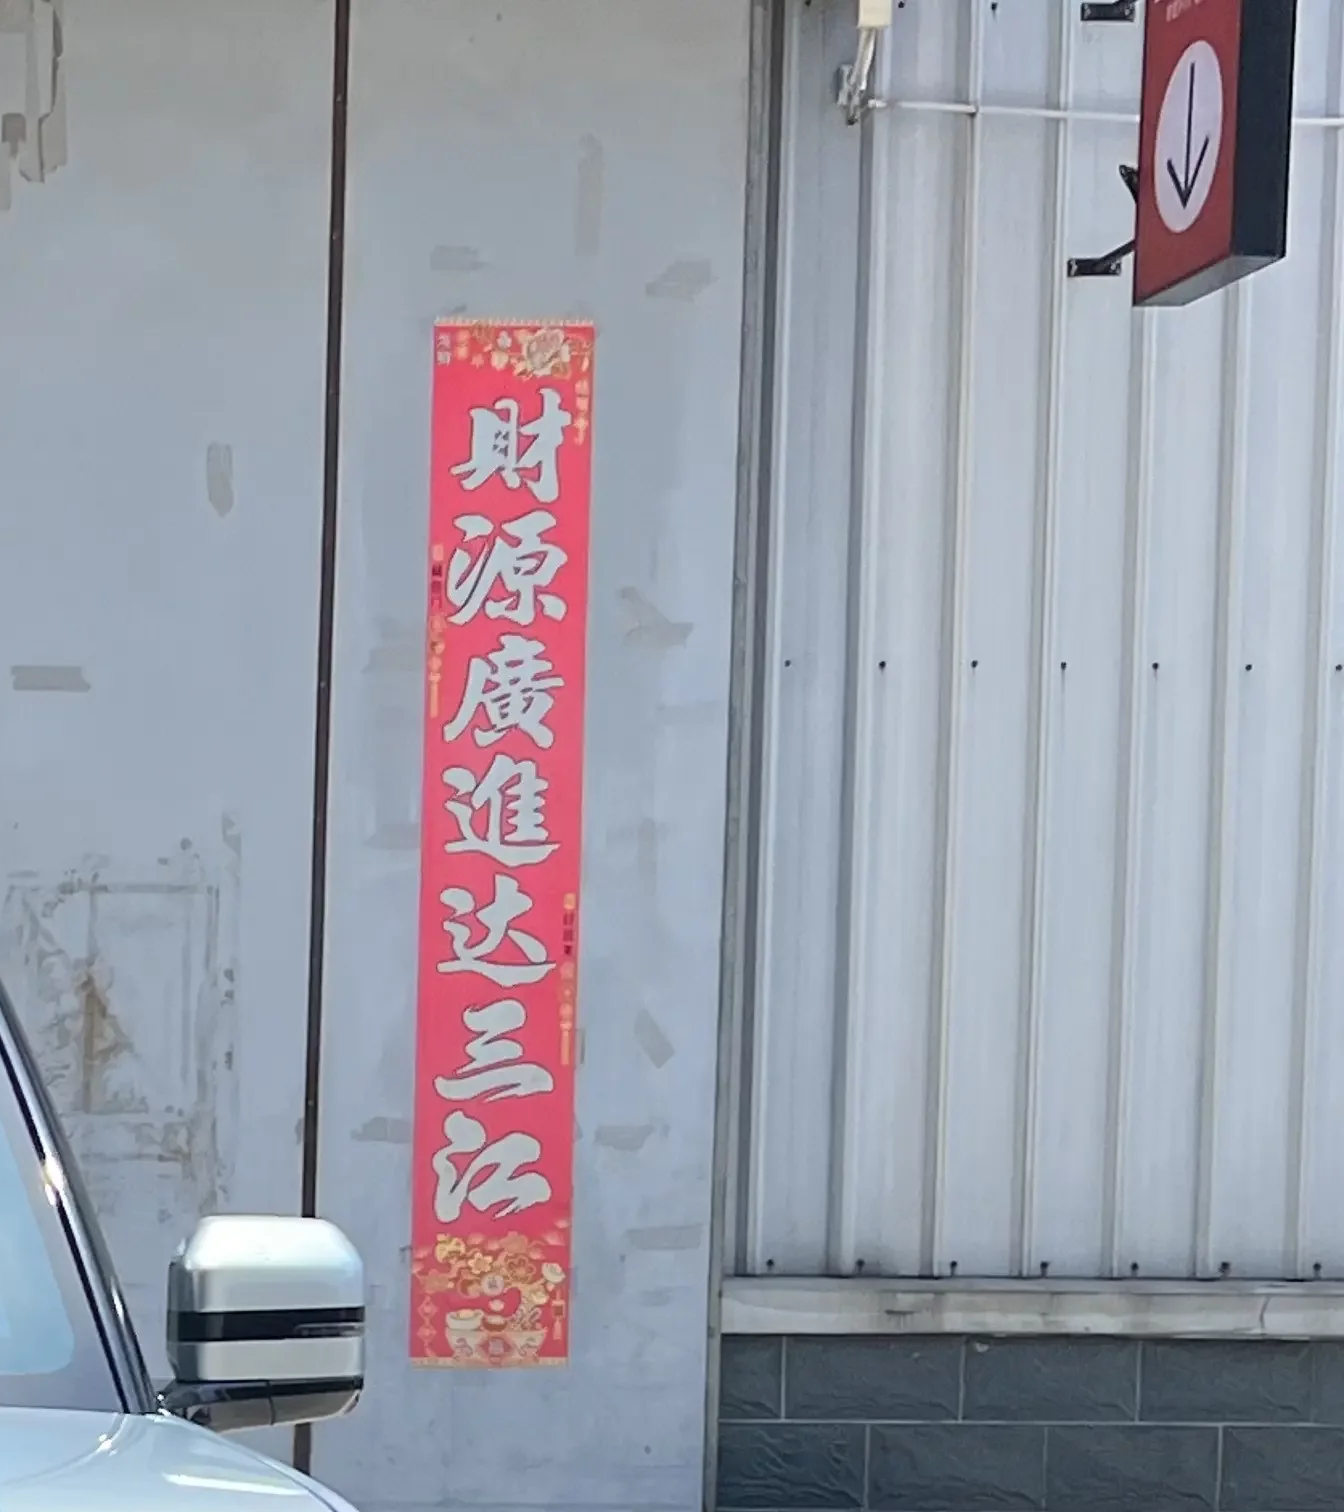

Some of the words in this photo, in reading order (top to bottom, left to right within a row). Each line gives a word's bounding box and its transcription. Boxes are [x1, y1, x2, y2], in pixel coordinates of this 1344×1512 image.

[432, 387, 574, 1224] 財源廣進达三江
